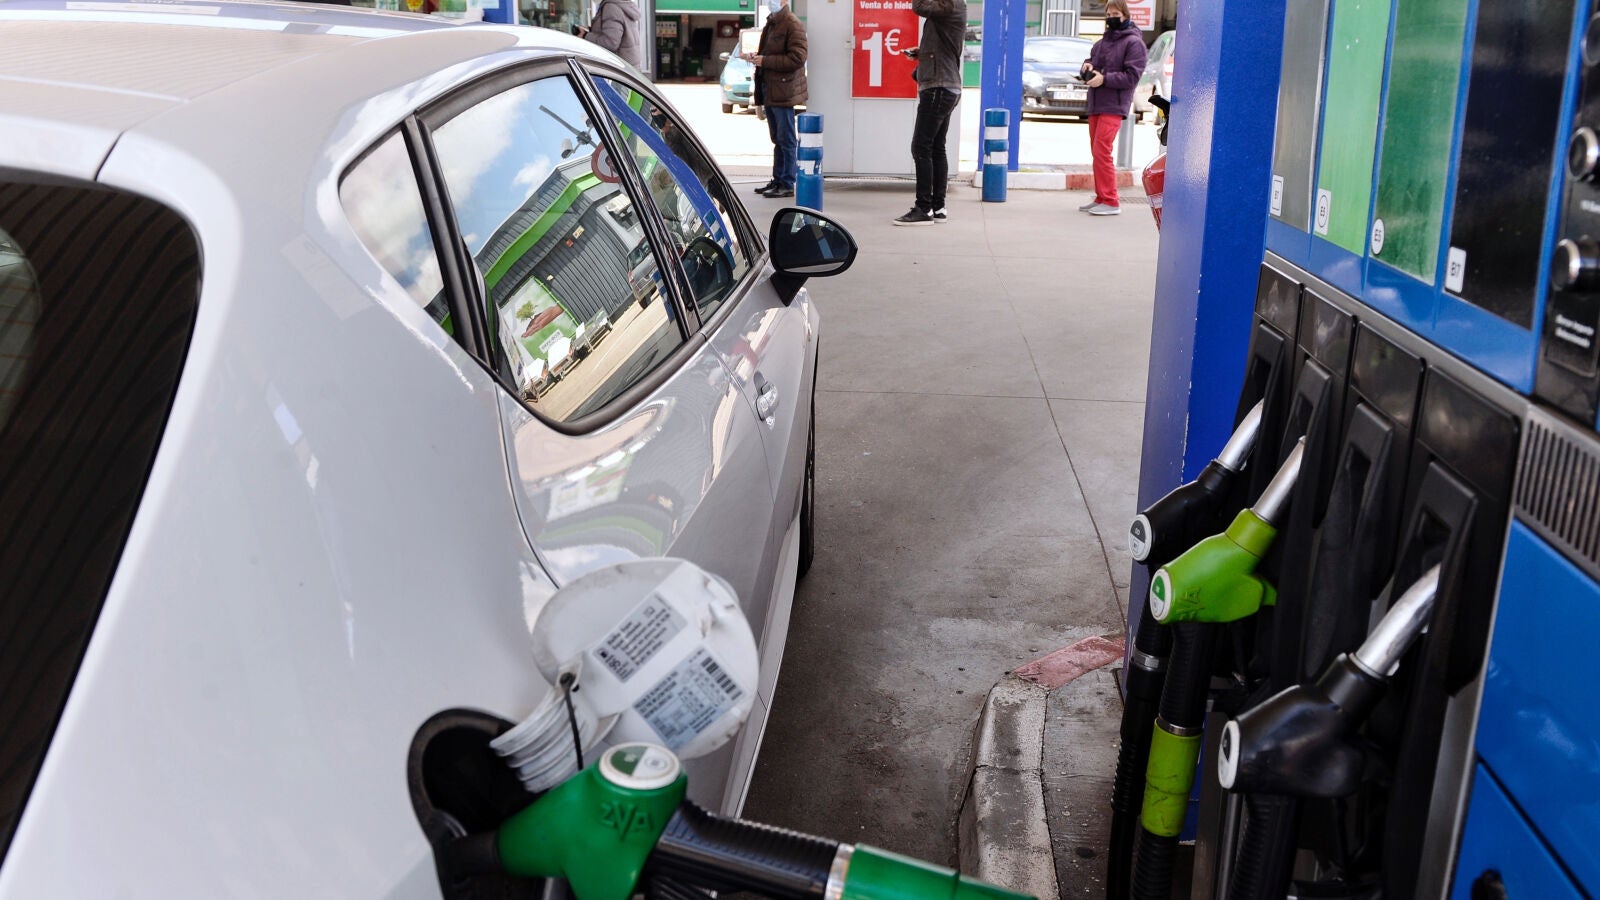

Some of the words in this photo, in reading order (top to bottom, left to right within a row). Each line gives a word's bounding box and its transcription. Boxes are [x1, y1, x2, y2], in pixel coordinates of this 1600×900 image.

[860, 1, 881, 9] Venta
[883, 1, 893, 9] de
[894, 1, 913, 9] hielo
